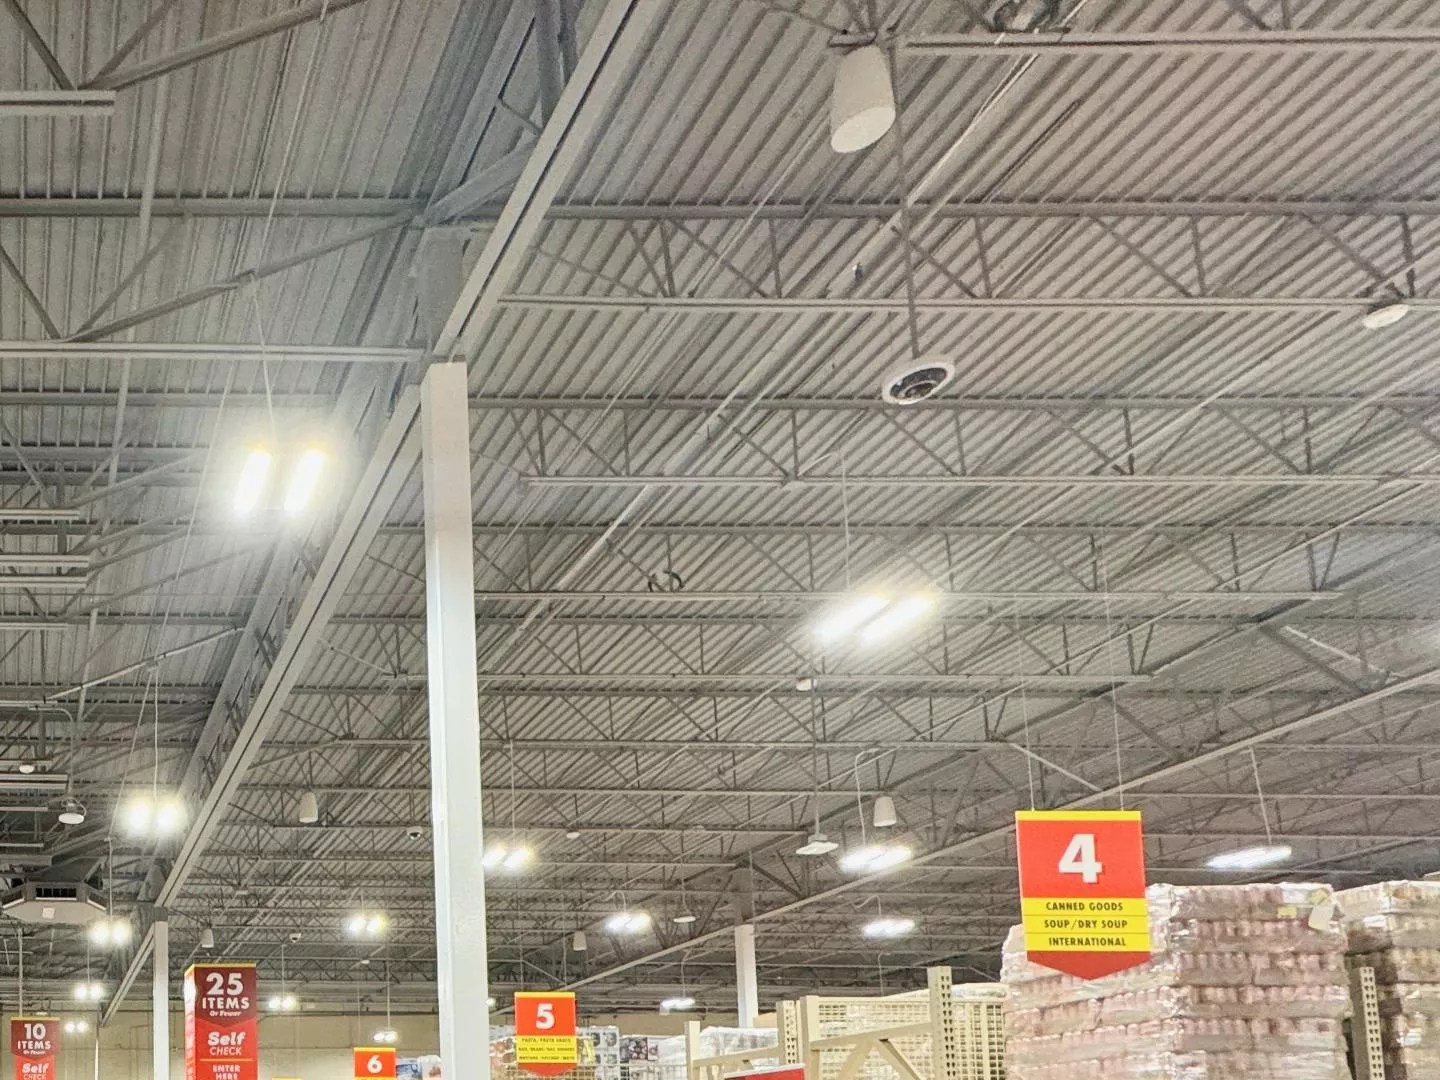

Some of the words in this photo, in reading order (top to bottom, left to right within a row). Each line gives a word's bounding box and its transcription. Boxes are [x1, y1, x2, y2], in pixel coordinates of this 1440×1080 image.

[1058, 833, 1103, 884] 4
[1046, 902, 1085, 911] CANNED
[1089, 902, 1123, 911] GOODS
[1101, 920, 1128, 929] SOUP
[1049, 937, 1127, 946] INTERNATIONAL
[206, 972, 244, 996] 25
[202, 997, 250, 1010] ITEMS
[535, 1003, 555, 1030] 5
[24, 1023, 46, 1040] 10
[208, 1031, 246, 1046] Self
[17, 1040, 51, 1050] ITEMS
[209, 1047, 242, 1055] CHECK
[22, 1063, 49, 1073] Self
[212, 1064, 240, 1073] ENTER
[367, 1055, 383, 1074] 6
